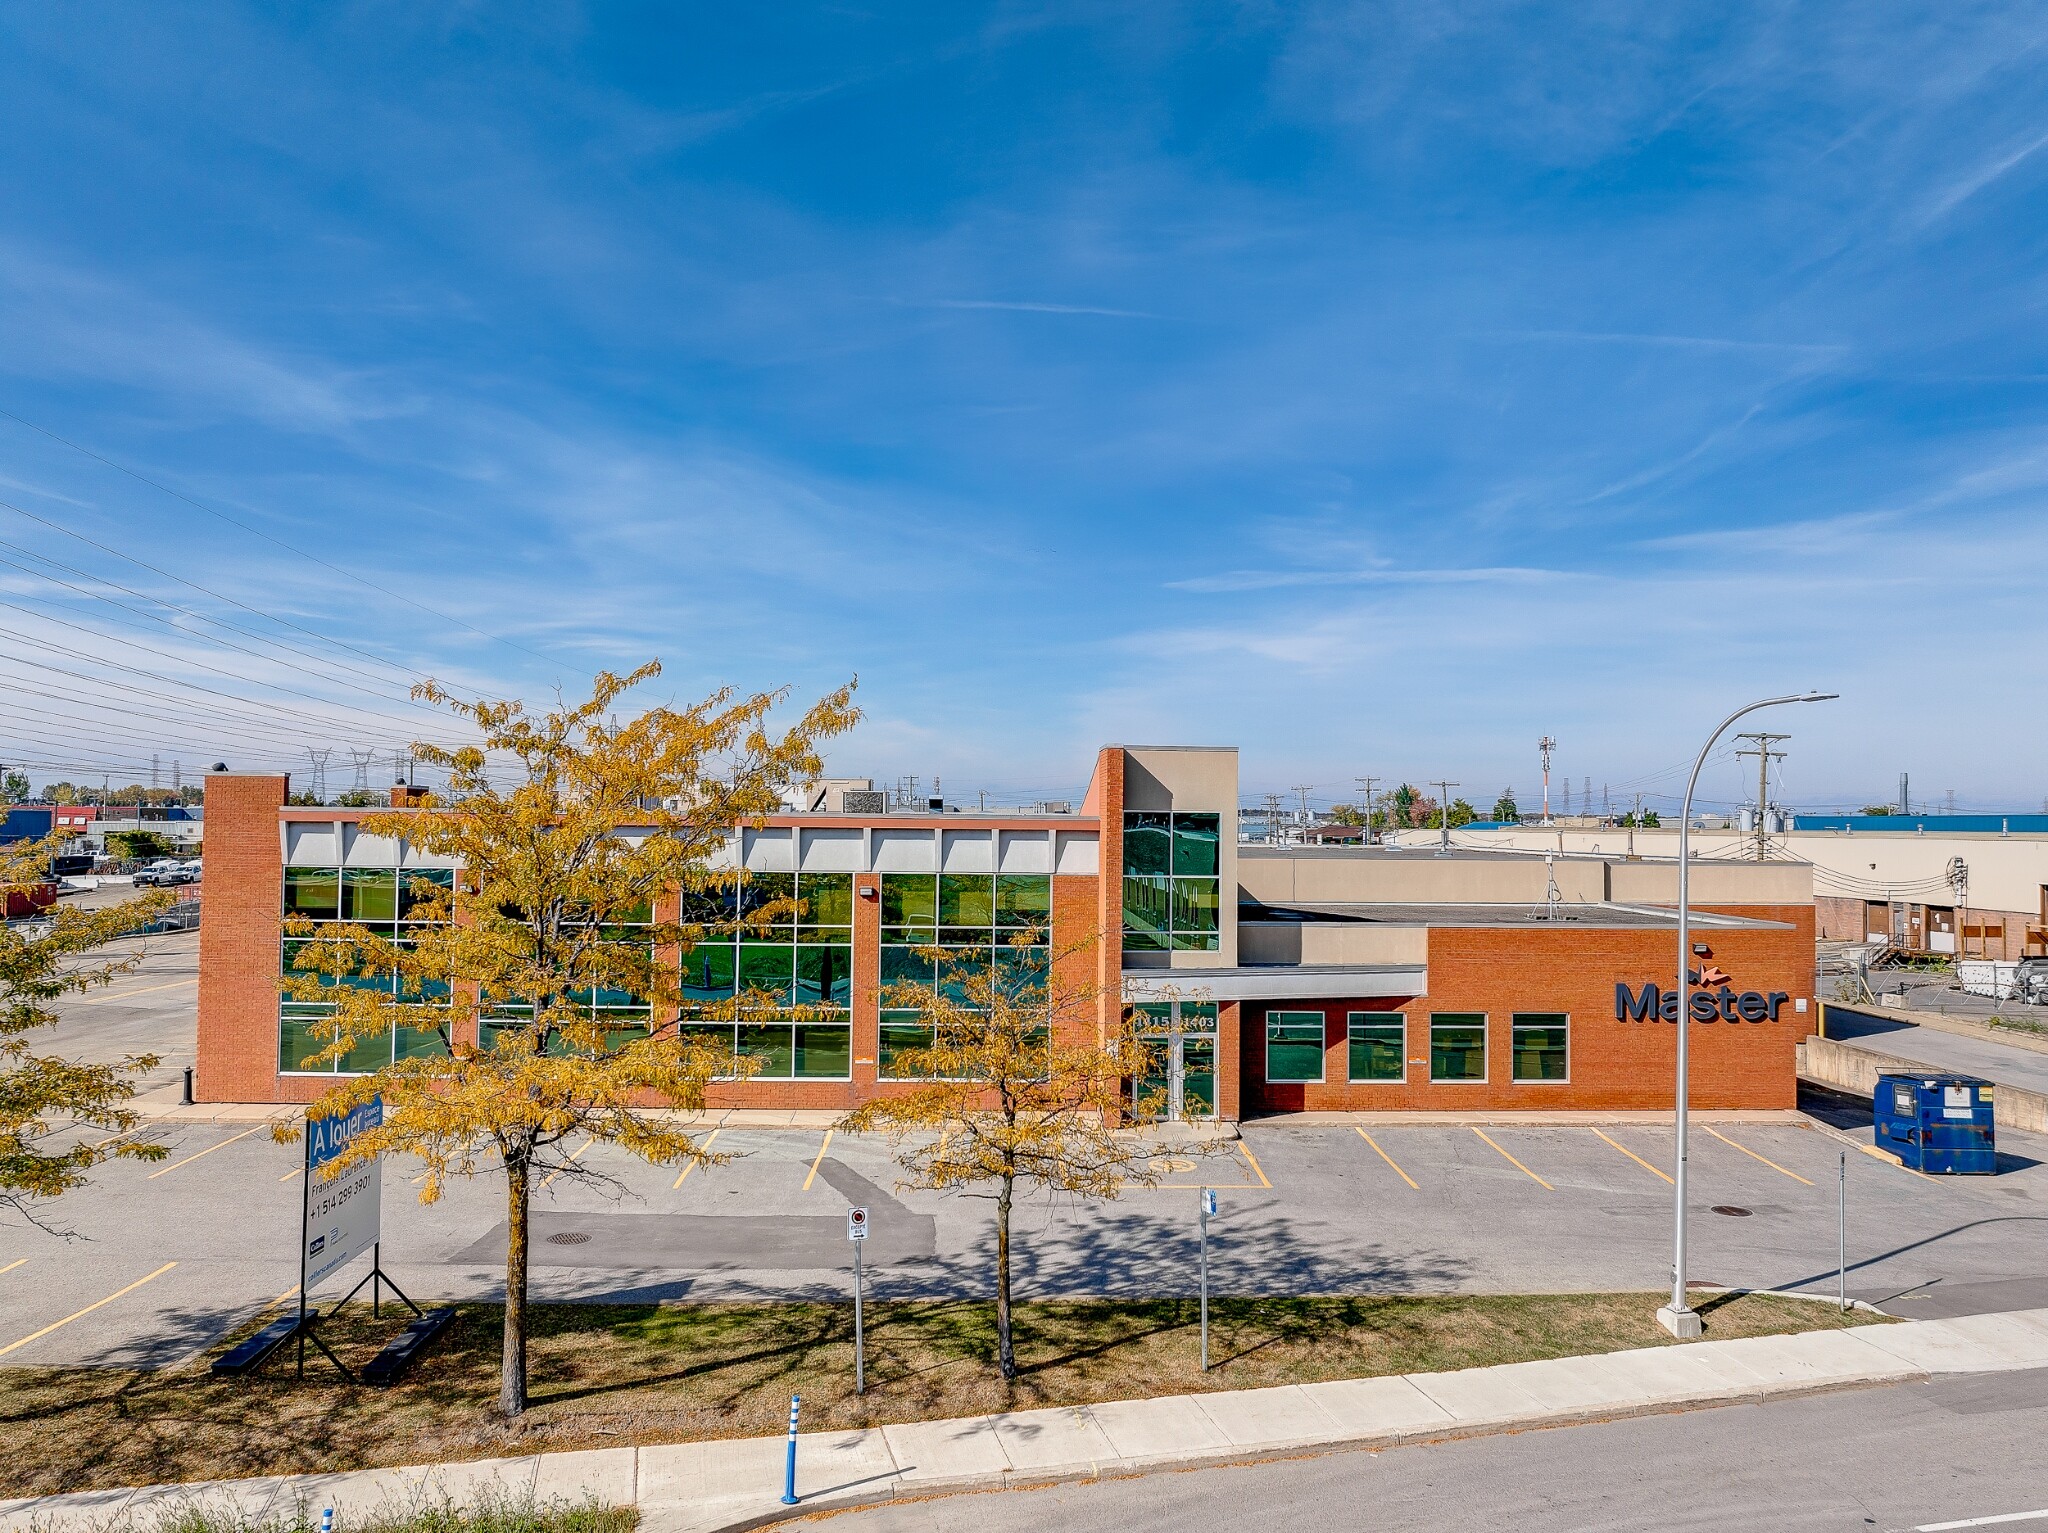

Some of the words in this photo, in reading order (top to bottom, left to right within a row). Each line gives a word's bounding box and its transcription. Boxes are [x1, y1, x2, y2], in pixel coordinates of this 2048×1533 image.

[1615, 982, 1787, 1020] Master
[313, 1122, 326, 1157] À
[329, 1111, 363, 1149] louer
[311, 1174, 339, 1198] François
[322, 1195, 337, 1216] 514
[338, 1185, 352, 1206] 299
[353, 1173, 371, 1196] 3901
